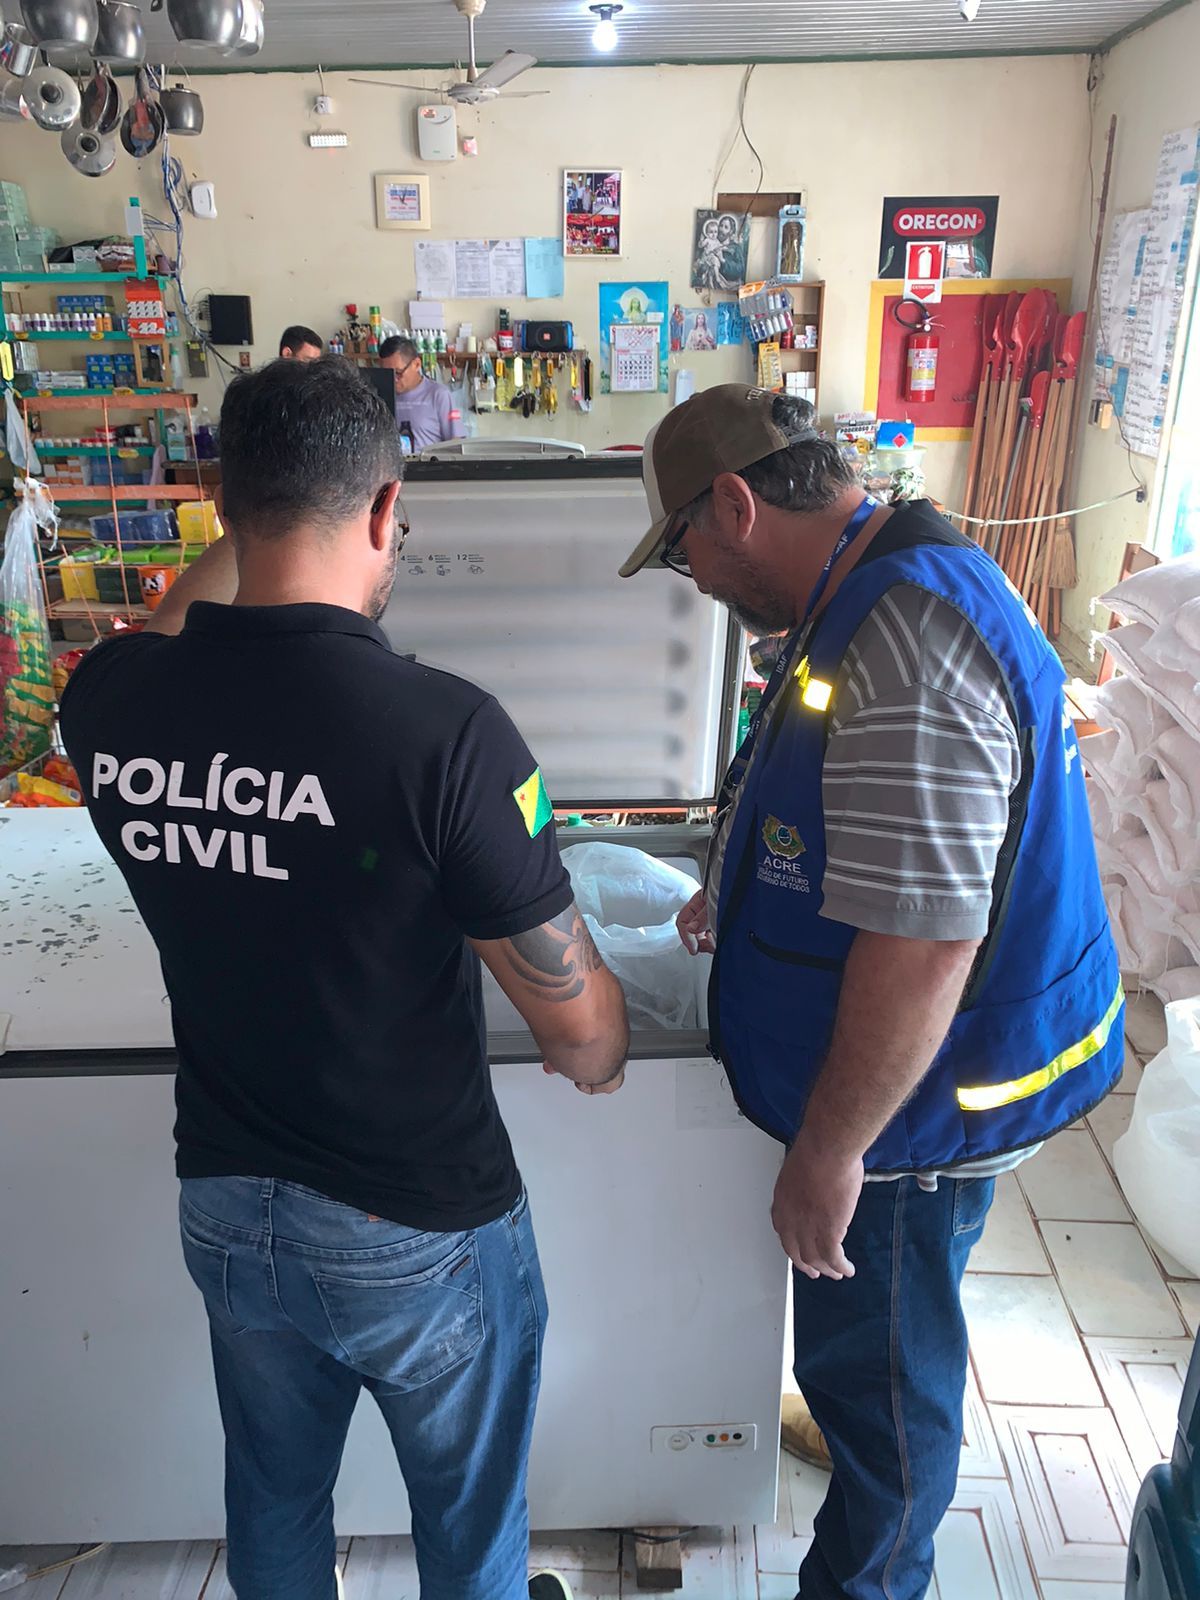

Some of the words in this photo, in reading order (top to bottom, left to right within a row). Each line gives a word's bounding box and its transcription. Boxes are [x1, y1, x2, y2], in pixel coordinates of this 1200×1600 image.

[898, 213, 977, 230] OREGON
[775, 654, 788, 675] IDAF
[92, 752, 336, 827] POLÍCIA
[121, 820, 289, 880] CIVIL
[763, 855, 801, 874] ACRE
